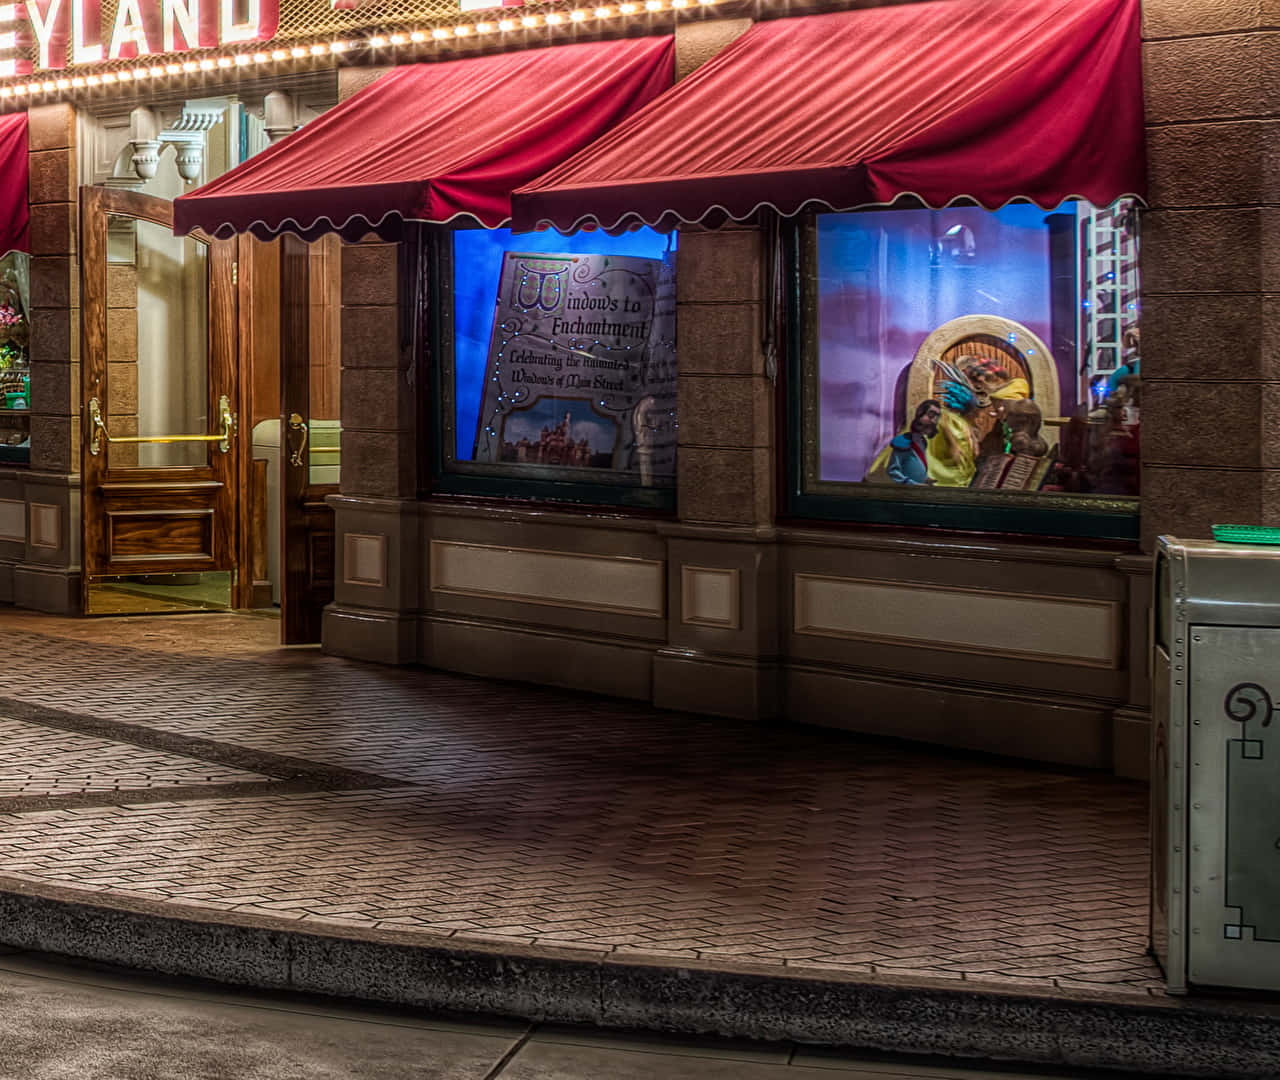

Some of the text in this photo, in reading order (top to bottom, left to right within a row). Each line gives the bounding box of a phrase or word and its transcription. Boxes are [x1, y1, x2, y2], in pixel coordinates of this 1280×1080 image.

[623, 295, 642, 314] to
[551, 315, 649, 342] Enchantment
[509, 349, 562, 370] Celebrating
[512, 367, 555, 386] Windows
[592, 373, 625, 391] Street
